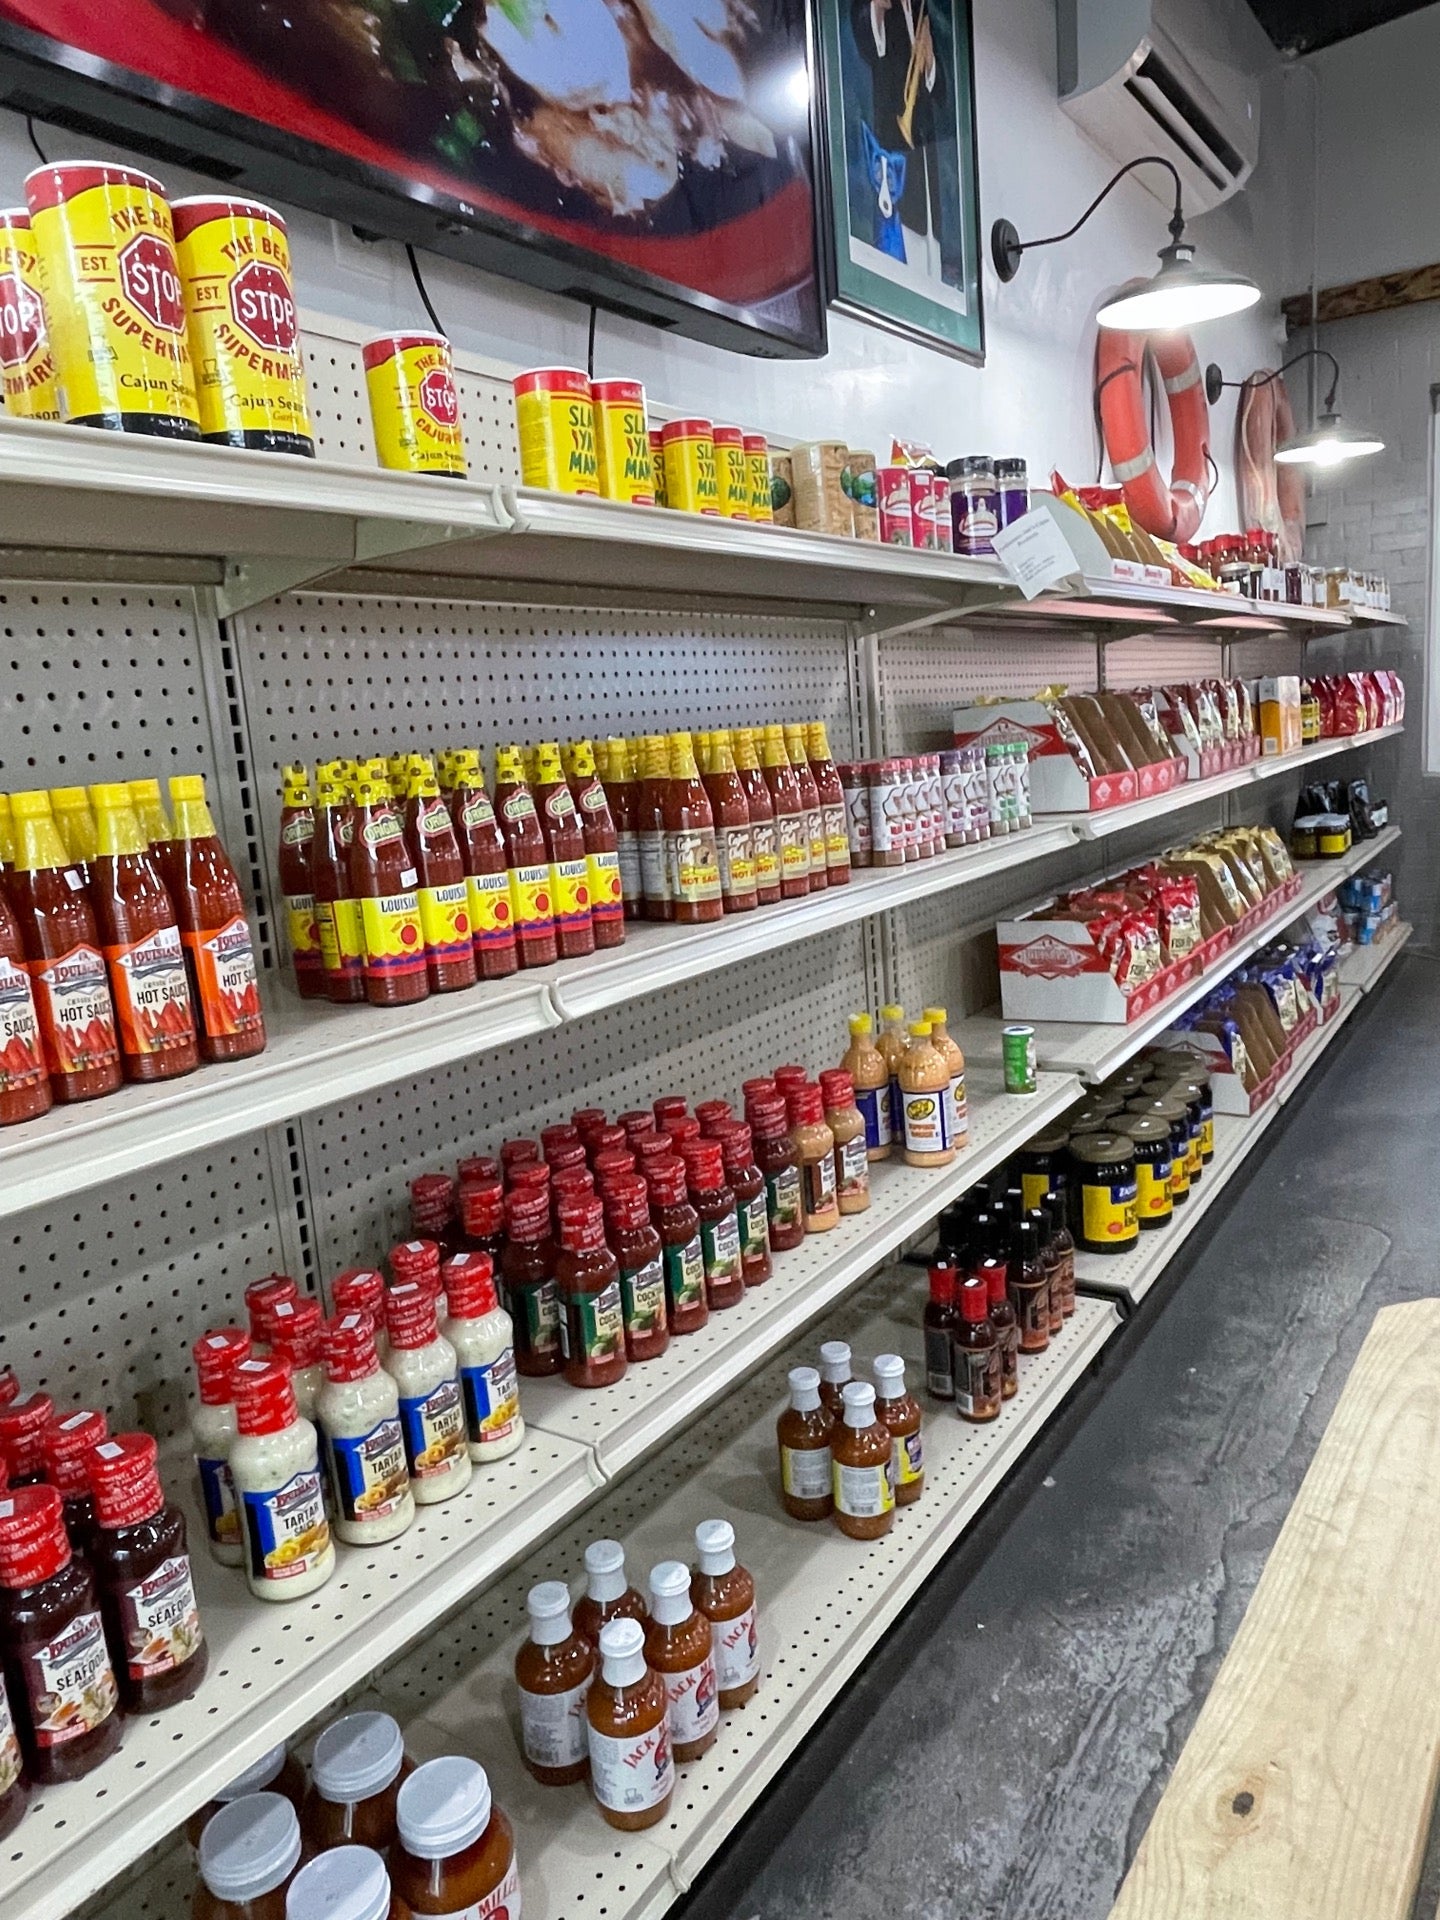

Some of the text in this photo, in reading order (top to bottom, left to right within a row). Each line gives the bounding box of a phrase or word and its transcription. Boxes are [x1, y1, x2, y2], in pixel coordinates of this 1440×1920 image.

[111, 206, 148, 232] THE
[221, 235, 257, 261] THE
[241, 288, 294, 326] STOP
[414, 353, 436, 372] THE
[120, 373, 168, 393] Cajun
[229, 393, 273, 411] Cajun
[222, 971, 243, 989] HOT
[136, 988, 160, 1006] HOT
[161, 981, 188, 1002] SAUCE
[4, 1015, 36, 1037] SAUCE
[60, 1006, 84, 1023] HOT
[371, 1446, 403, 1475] TARTAR
[283, 1501, 320, 1531] TARTAR
[722, 1619, 749, 1650] JACK
[56, 1648, 106, 1692] SEAFOOD
[666, 1673, 697, 1703] JACK
[622, 1736, 656, 1770] JACK
